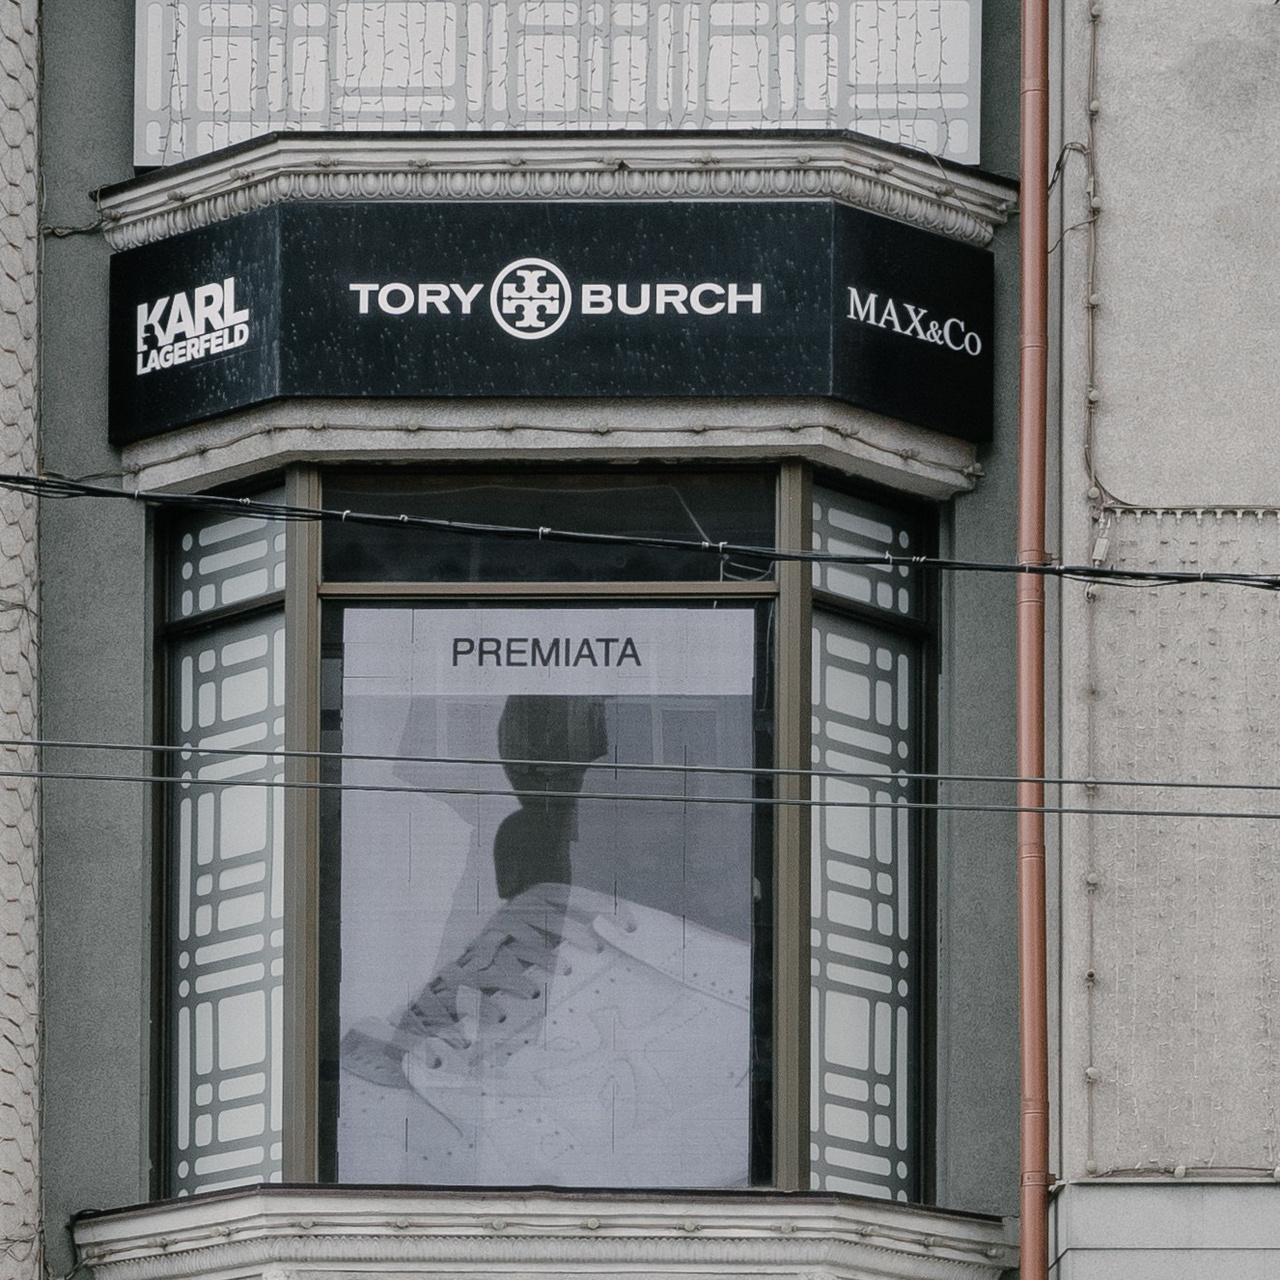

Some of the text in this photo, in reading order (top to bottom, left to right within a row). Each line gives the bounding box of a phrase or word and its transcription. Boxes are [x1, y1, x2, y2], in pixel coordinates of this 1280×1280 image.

[137, 277, 250, 353] KARL
[349, 282, 762, 315] TORY BURCH
[136, 323, 250, 376] LAGERFELD
[452, 637, 642, 667] PREMIATA
